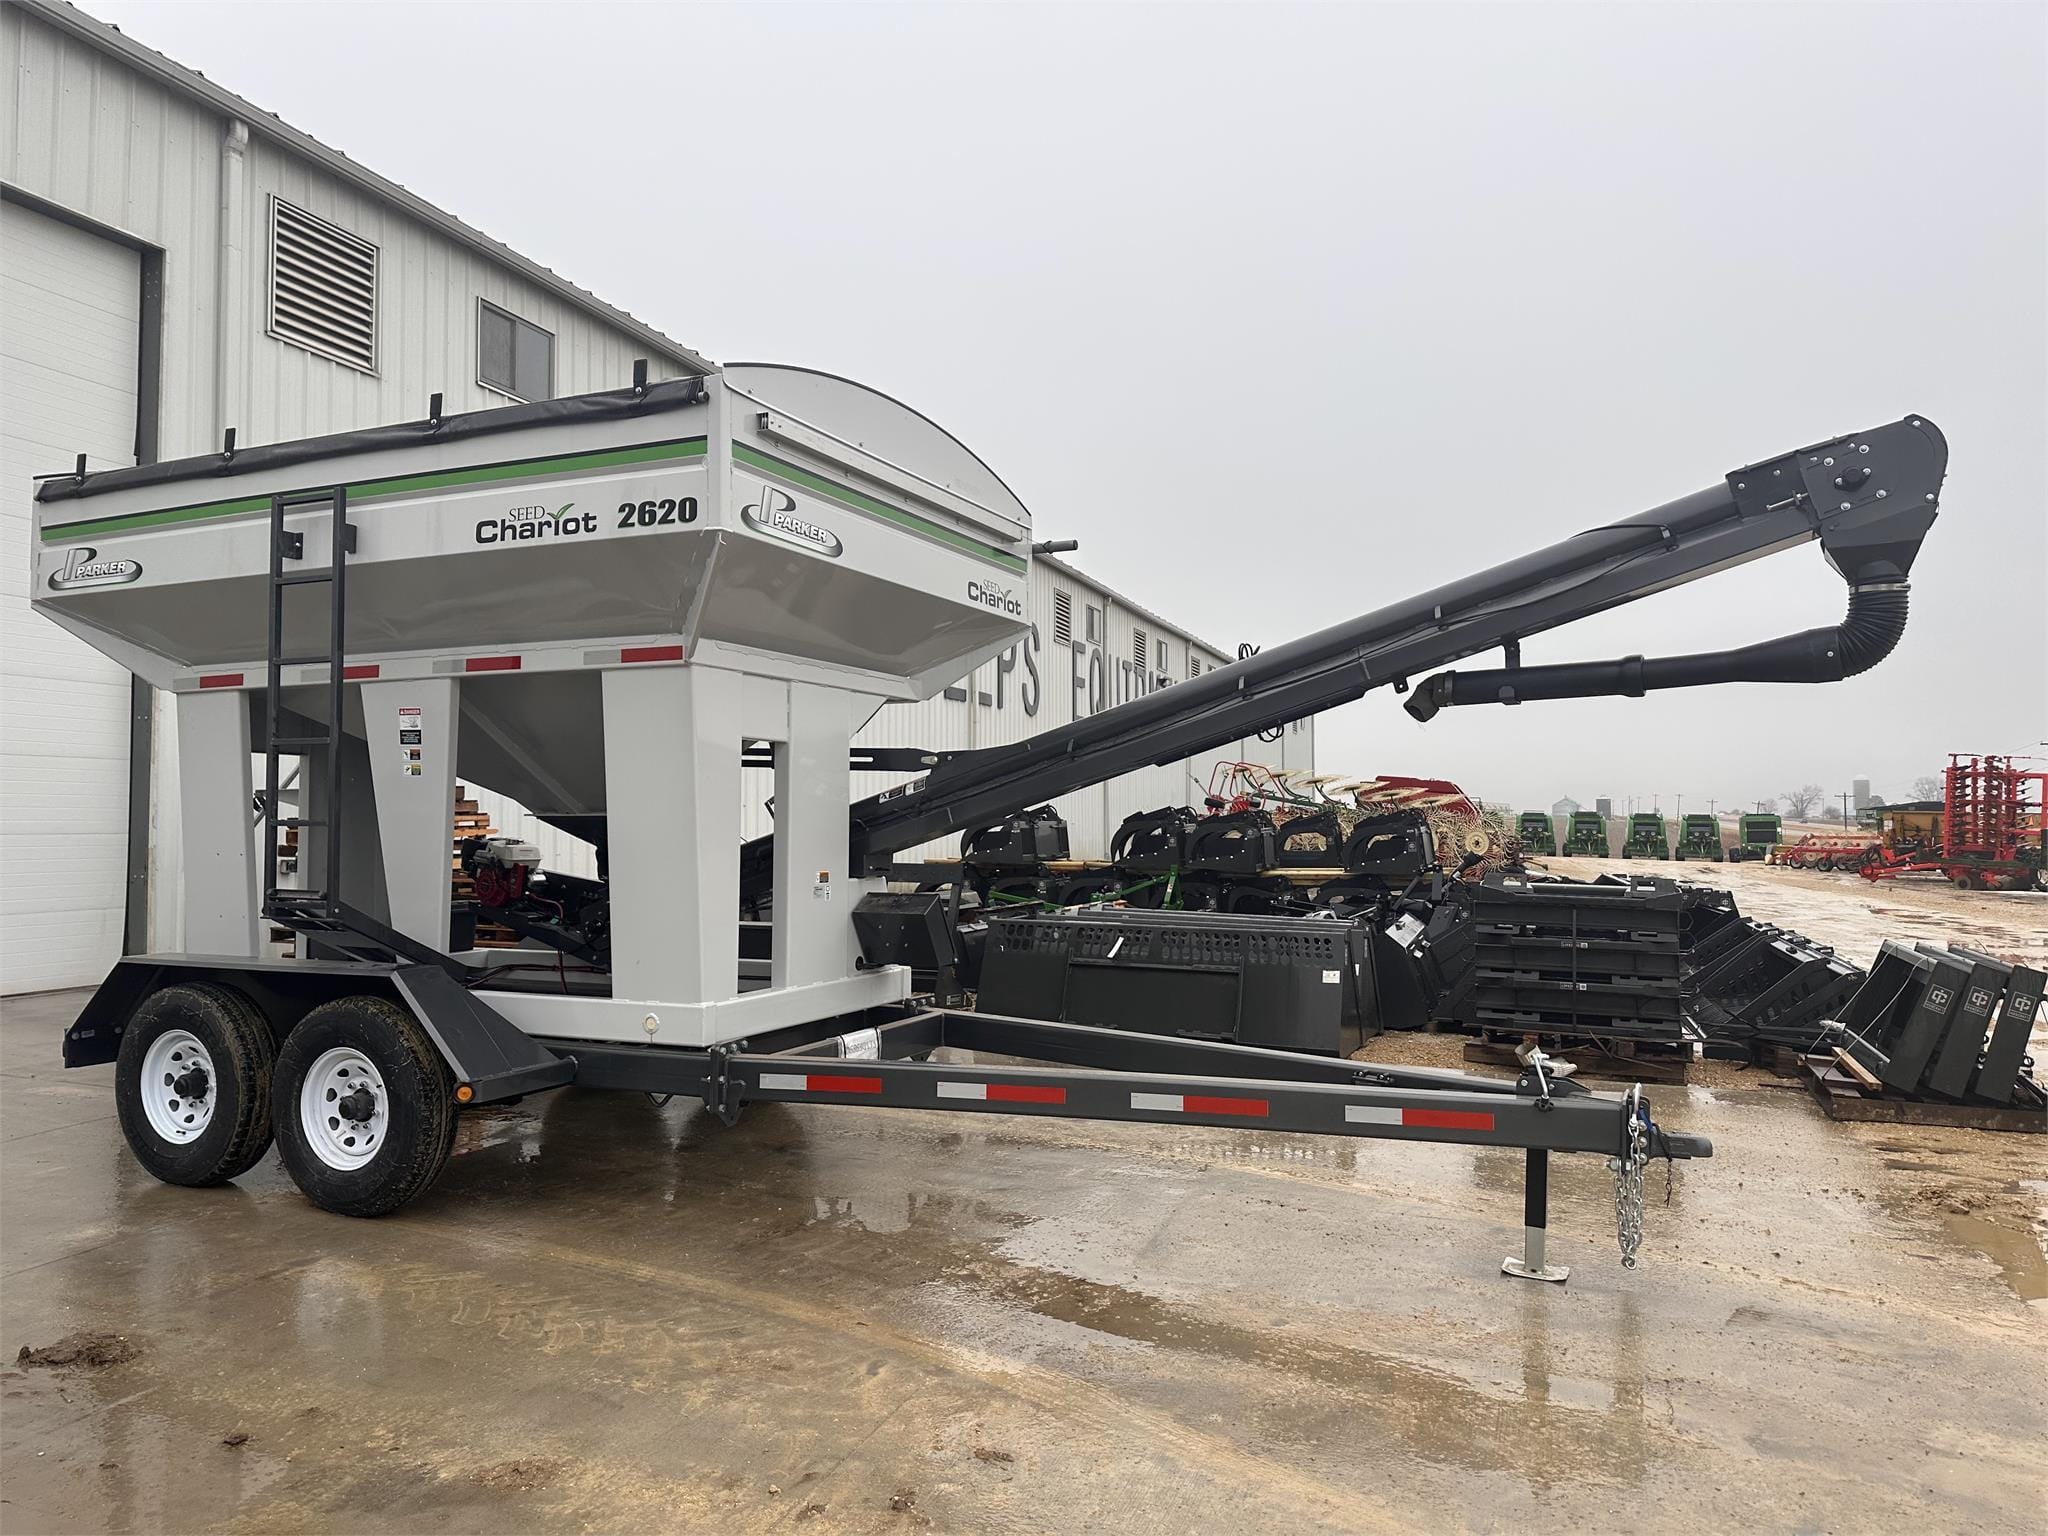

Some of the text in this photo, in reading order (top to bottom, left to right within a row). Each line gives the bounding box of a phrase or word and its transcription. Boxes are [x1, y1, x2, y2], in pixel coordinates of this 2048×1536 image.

[475, 512, 598, 544] Chariot
[508, 505, 546, 522] SEED
[617, 496, 698, 529] 2620
[774, 511, 828, 543] PARKER
[75, 561, 126, 578] PARKER
[968, 581, 1021, 615] Chariot
[983, 579, 1001, 595] SEED
